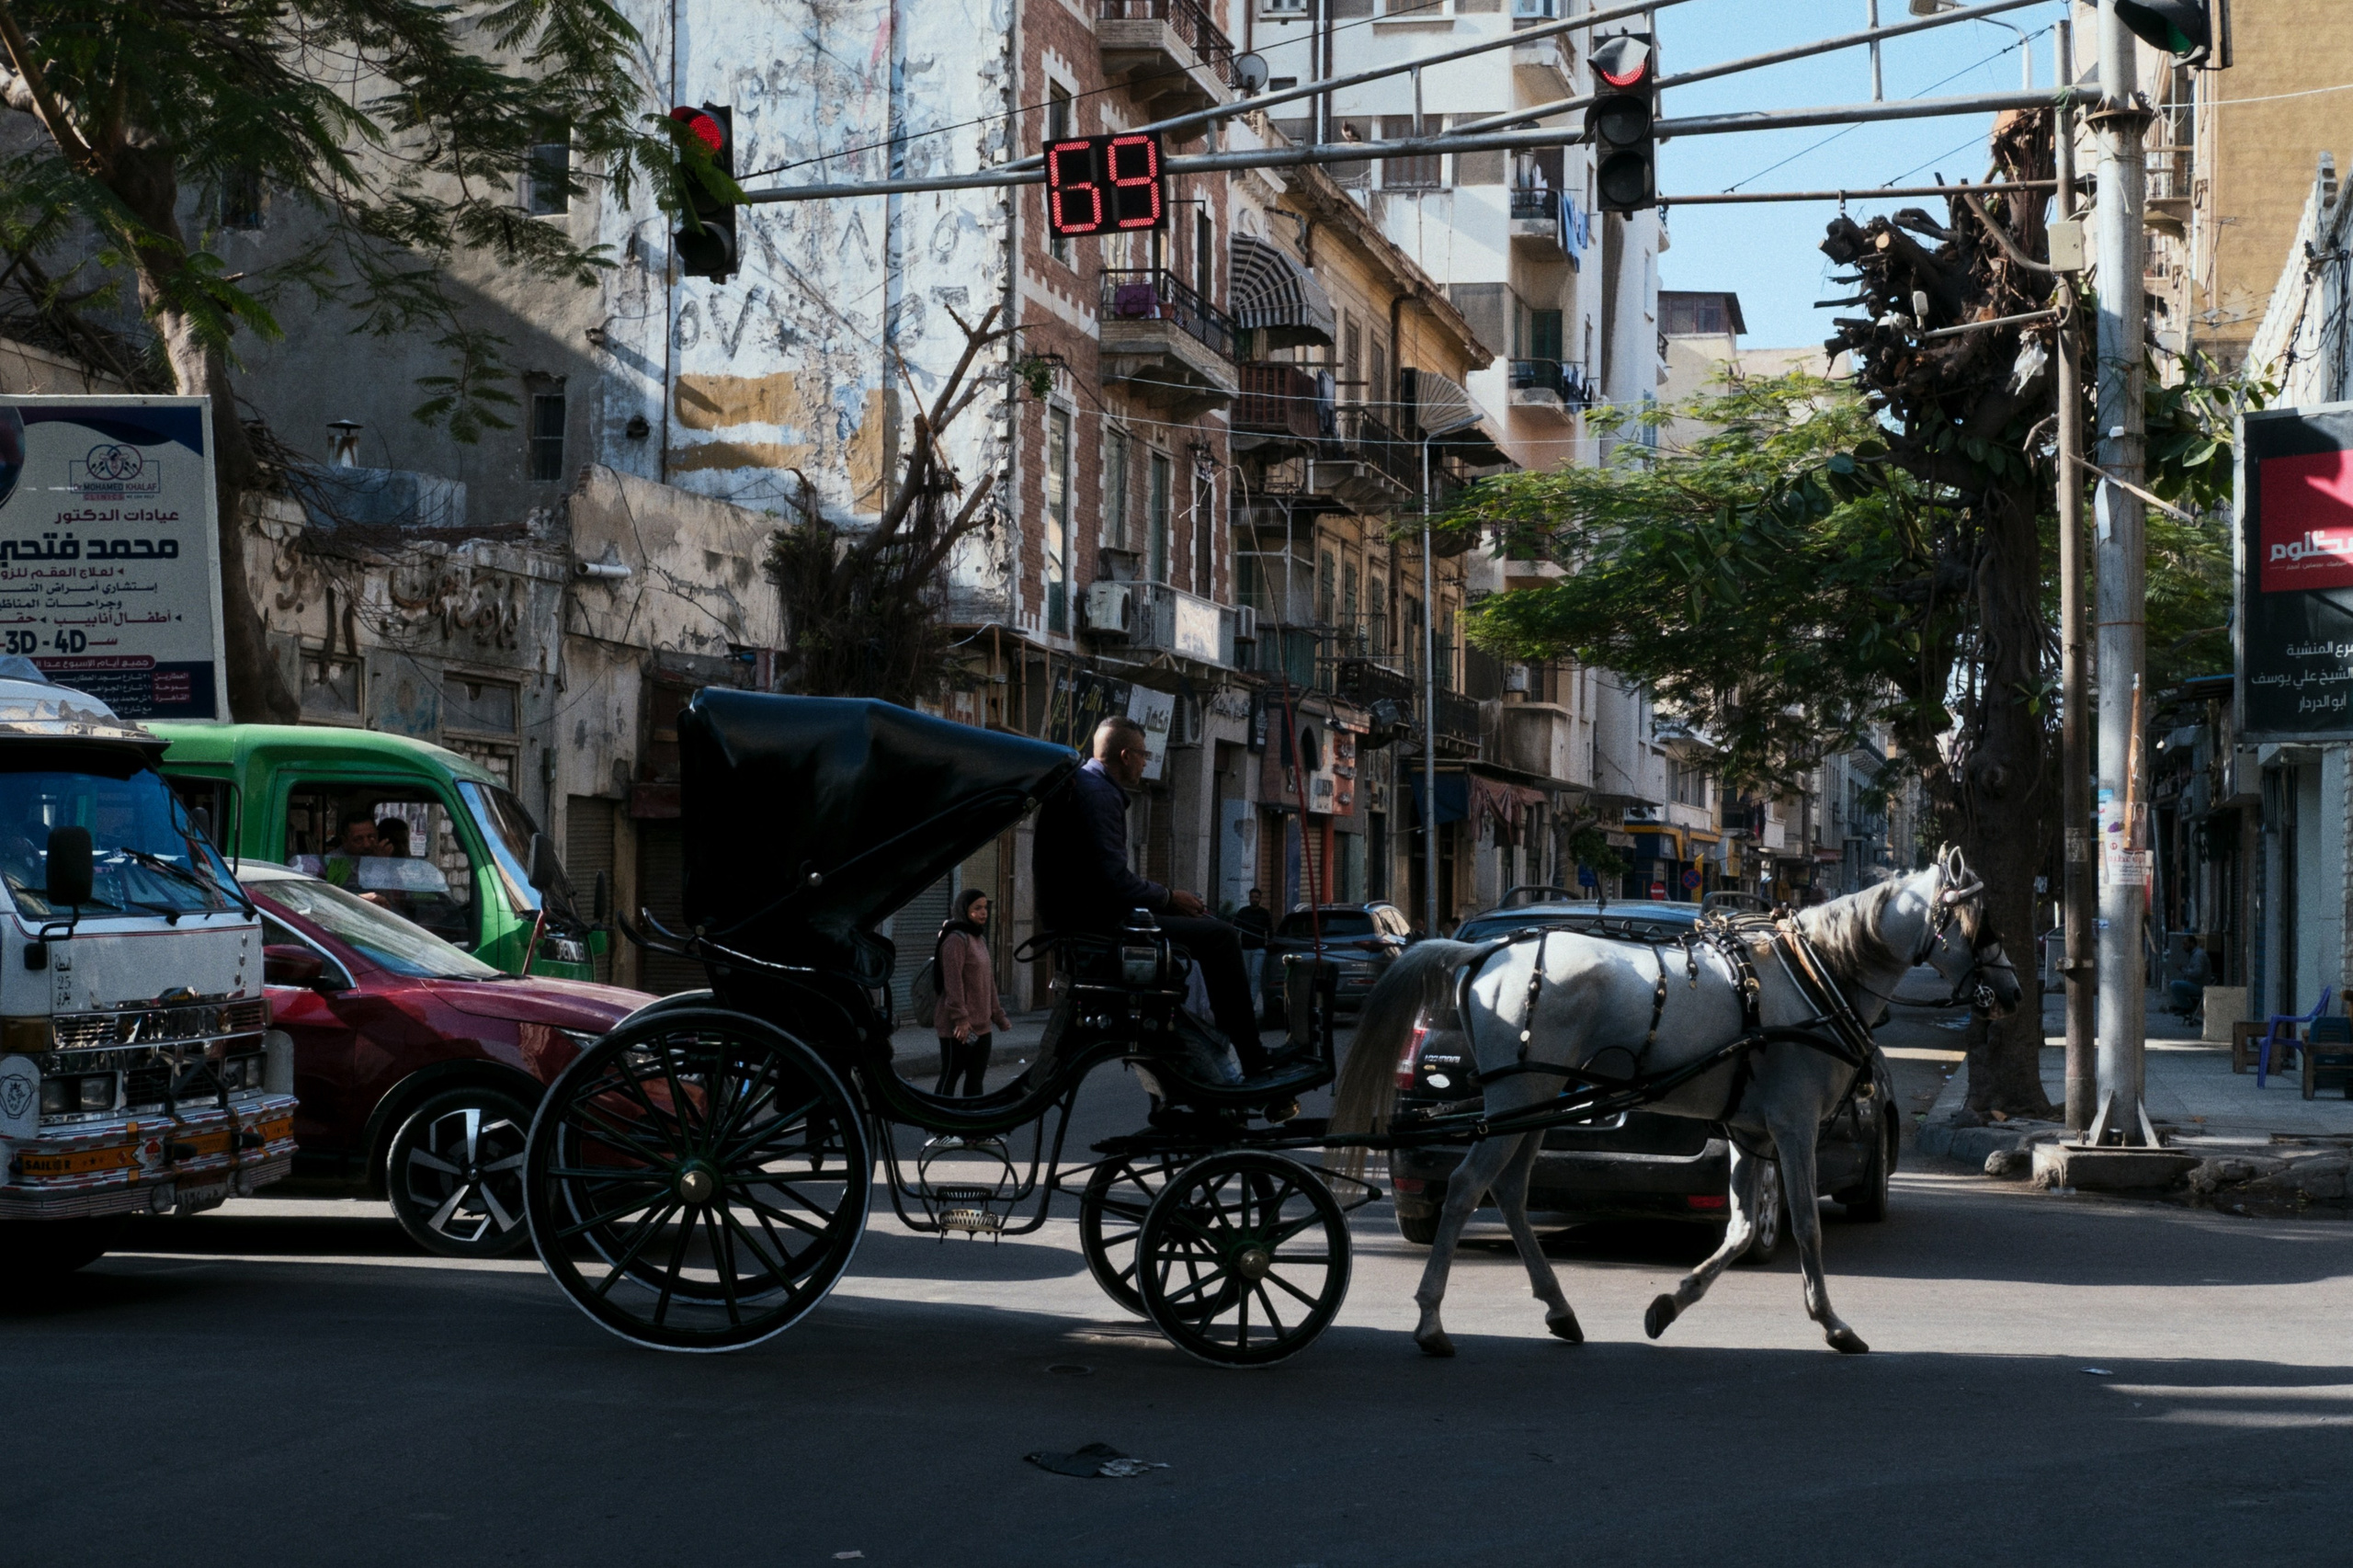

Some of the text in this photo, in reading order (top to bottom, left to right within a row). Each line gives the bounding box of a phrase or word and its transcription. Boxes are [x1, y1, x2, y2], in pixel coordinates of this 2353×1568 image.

[1049, 135, 1161, 233] 69
[53, 508, 179, 525] عيادات الدكتور
[0, 532, 178, 568] محمد فتحي
[31, 567, 76, 580] العقم
[79, 566, 114, 579] لعلاج
[47, 581, 99, 595] أمراض
[102, 582, 158, 595] إستشاري
[0, 598, 122, 611] وجراحات المناظ
[53, 610, 171, 628] أطفال أنابيب
[6, 631, 38, 654] 3D
[54, 630, 87, 653] 4D
[2286, 641, 2334, 659] المنشية
[121, 658, 149, 668] جميع
[2251, 672, 2291, 687] يوسف
[2292, 669, 2317, 690] علي
[2298, 691, 2347, 713] أبو الدردار
[57, 975, 72, 990] 25
